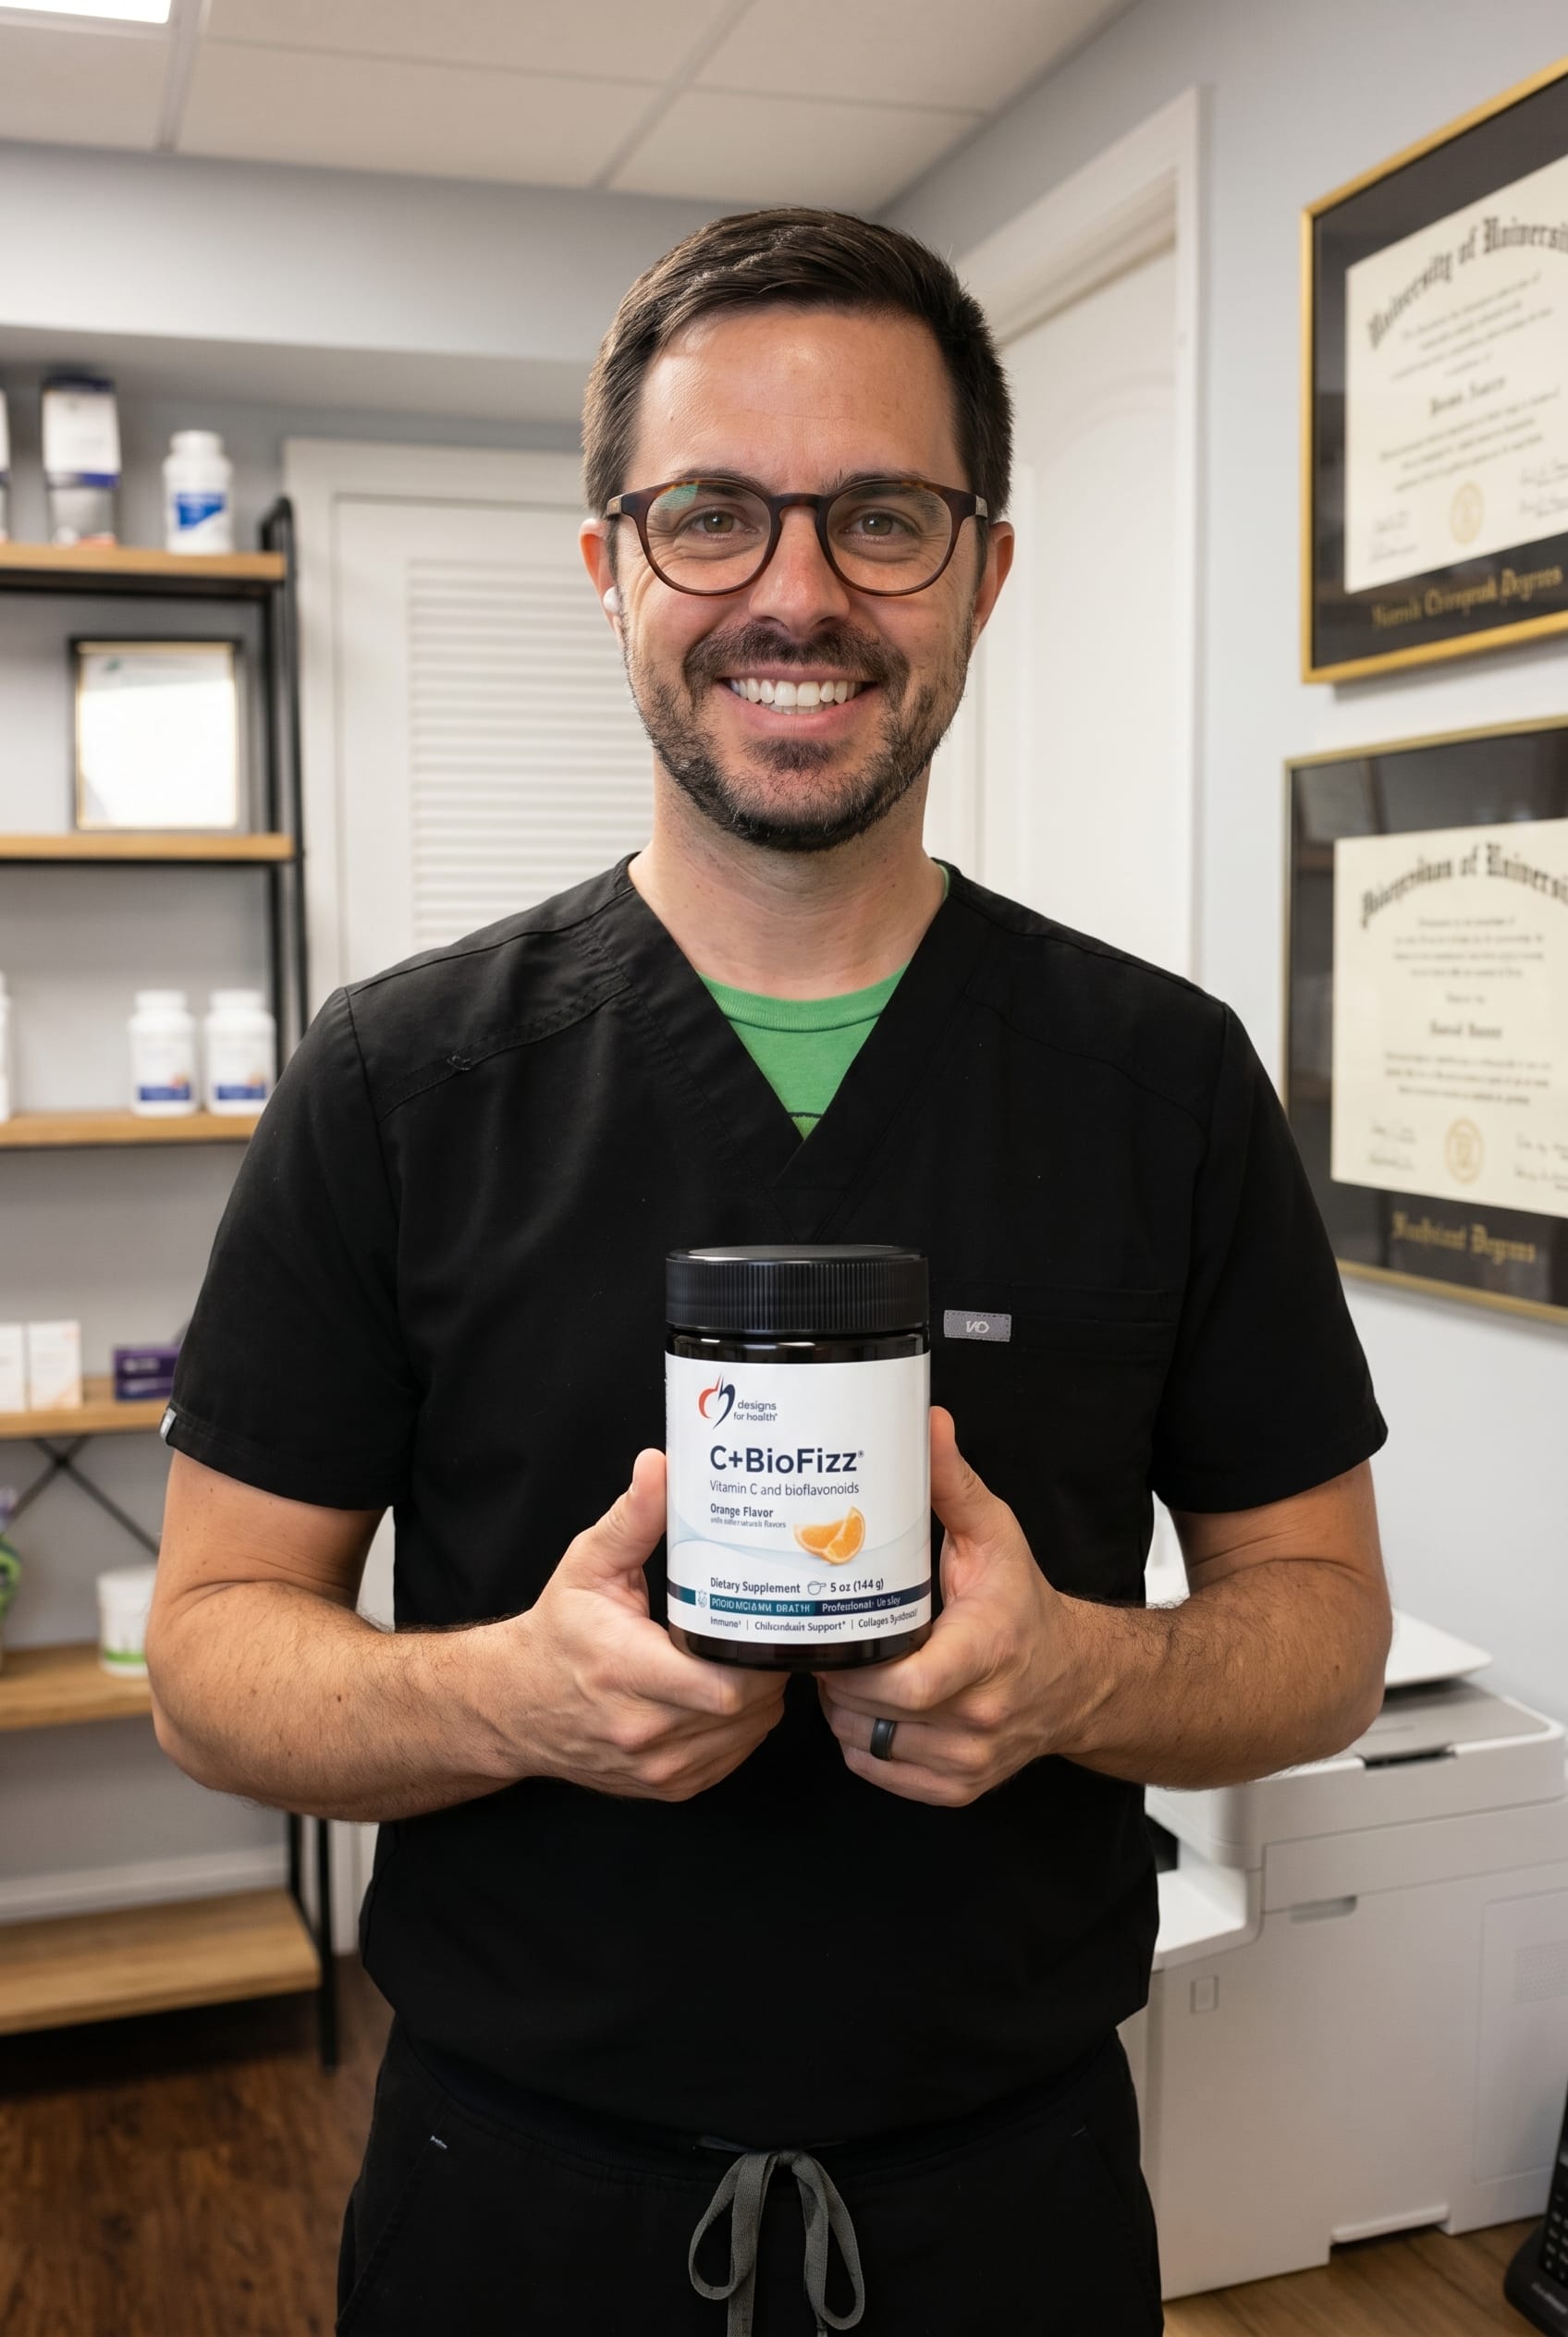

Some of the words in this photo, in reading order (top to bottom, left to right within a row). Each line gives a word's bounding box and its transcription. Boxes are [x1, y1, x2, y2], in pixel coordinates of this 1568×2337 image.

[737, 1400, 777, 1413] designs
[710, 1480, 747, 1494] Vitamin
[750, 1483, 758, 1496] C
[761, 1484, 782, 1496] and
[785, 1482, 860, 1496] bioflavonoids
[710, 1503, 741, 1518] Orange
[743, 1506, 774, 1518] Flavor
[710, 1577, 741, 1594] Dietary
[742, 1581, 801, 1595] Supplement
[830, 1583, 836, 1592] 5
[839, 1583, 851, 1592] oz
[853, 1579, 874, 1592] (144
[876, 1577, 884, 1590] g)
